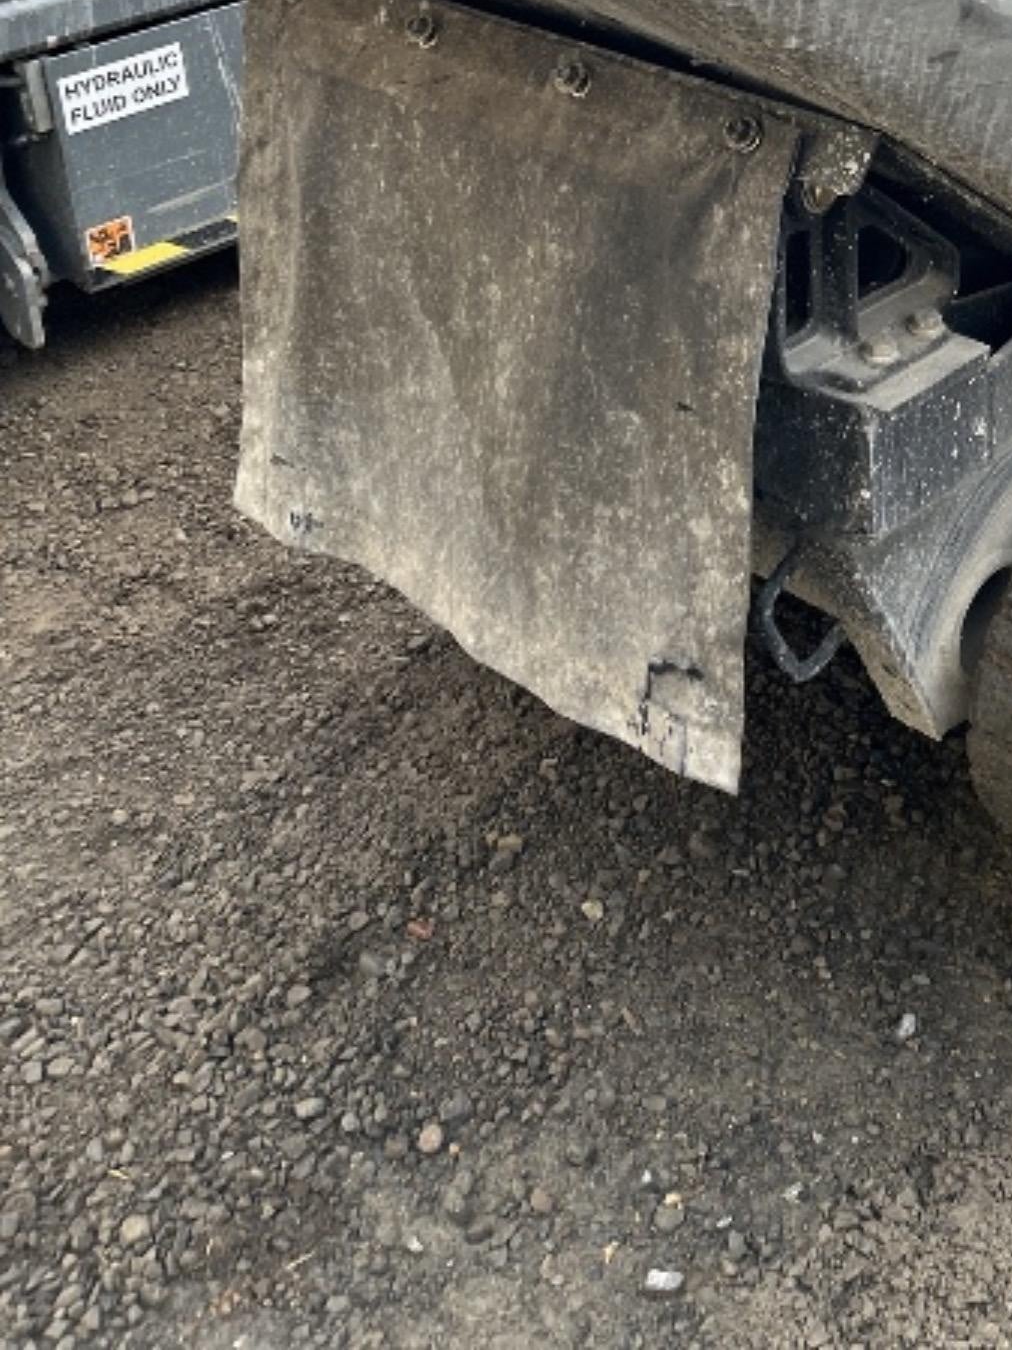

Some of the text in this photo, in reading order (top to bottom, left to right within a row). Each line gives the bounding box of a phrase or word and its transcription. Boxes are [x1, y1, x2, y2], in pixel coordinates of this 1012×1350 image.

[64, 50, 179, 100] HYDRAULIC
[70, 73, 181, 125] FLUID ONLY
